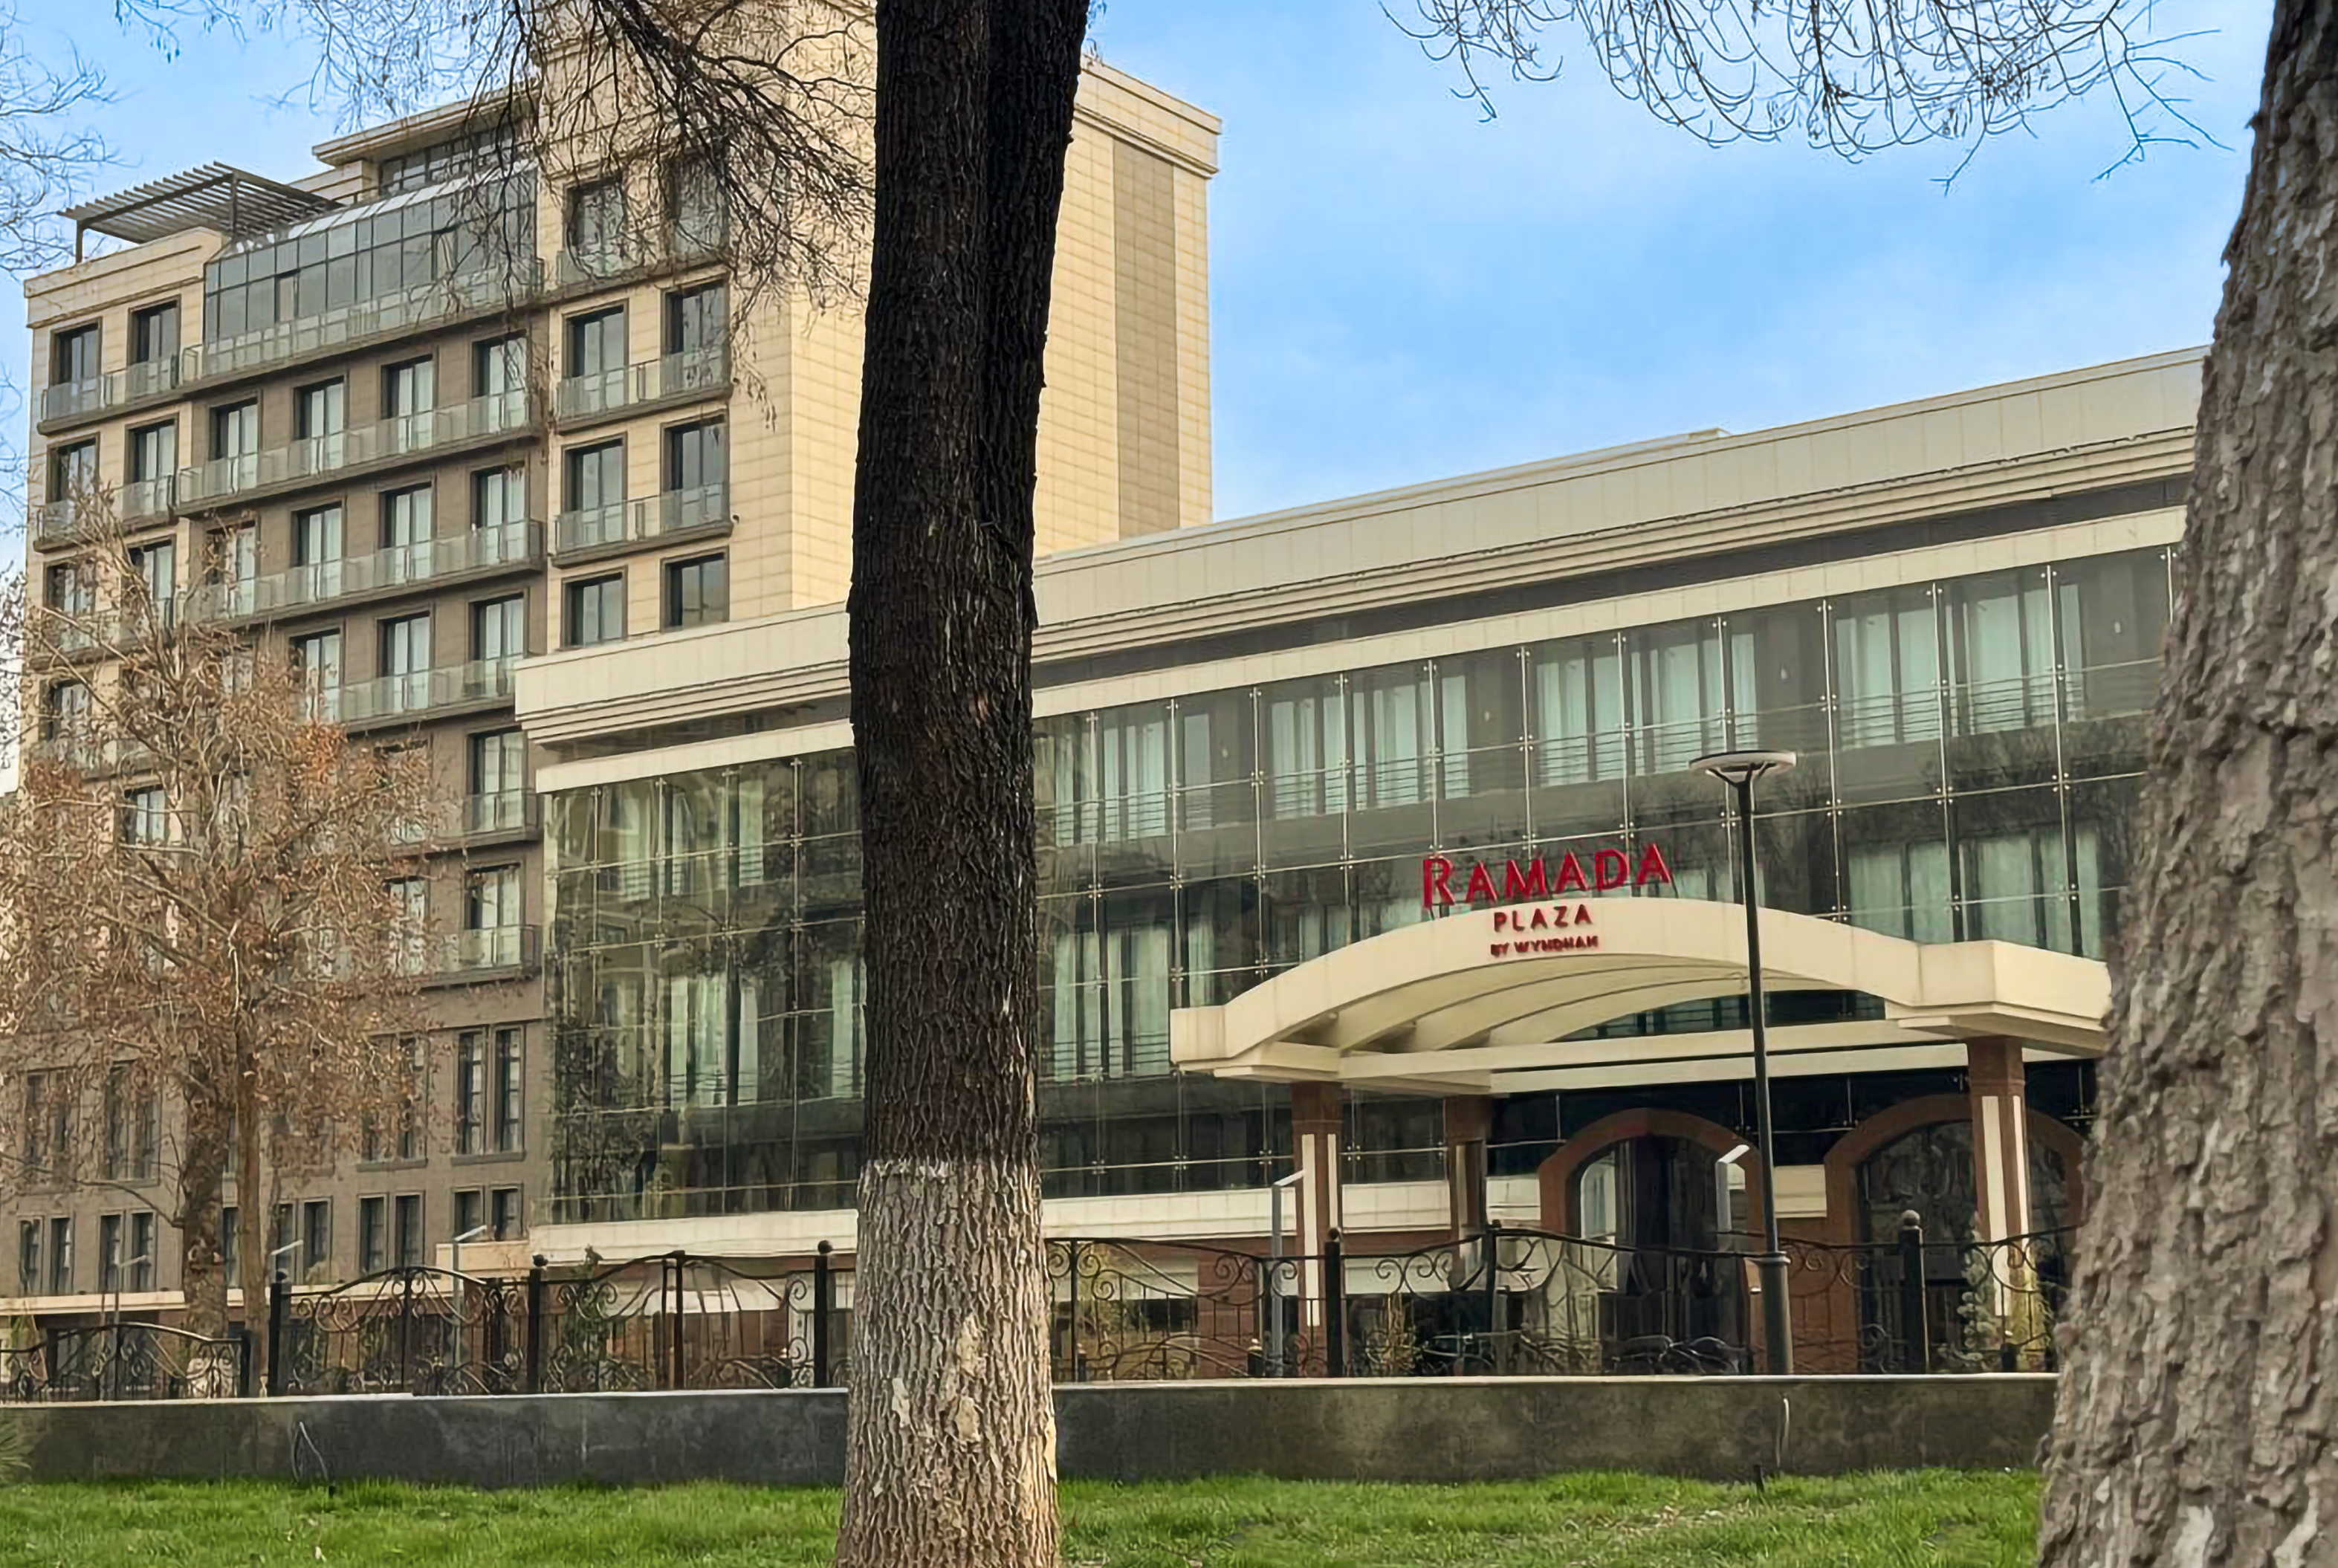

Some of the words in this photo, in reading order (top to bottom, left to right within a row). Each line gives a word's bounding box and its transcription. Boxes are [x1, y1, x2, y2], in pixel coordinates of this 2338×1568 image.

[1422, 843, 1672, 909] RAMADA
[1494, 904, 1592, 932] PLAZA
[1514, 935, 1599, 953] WYNDHAM
